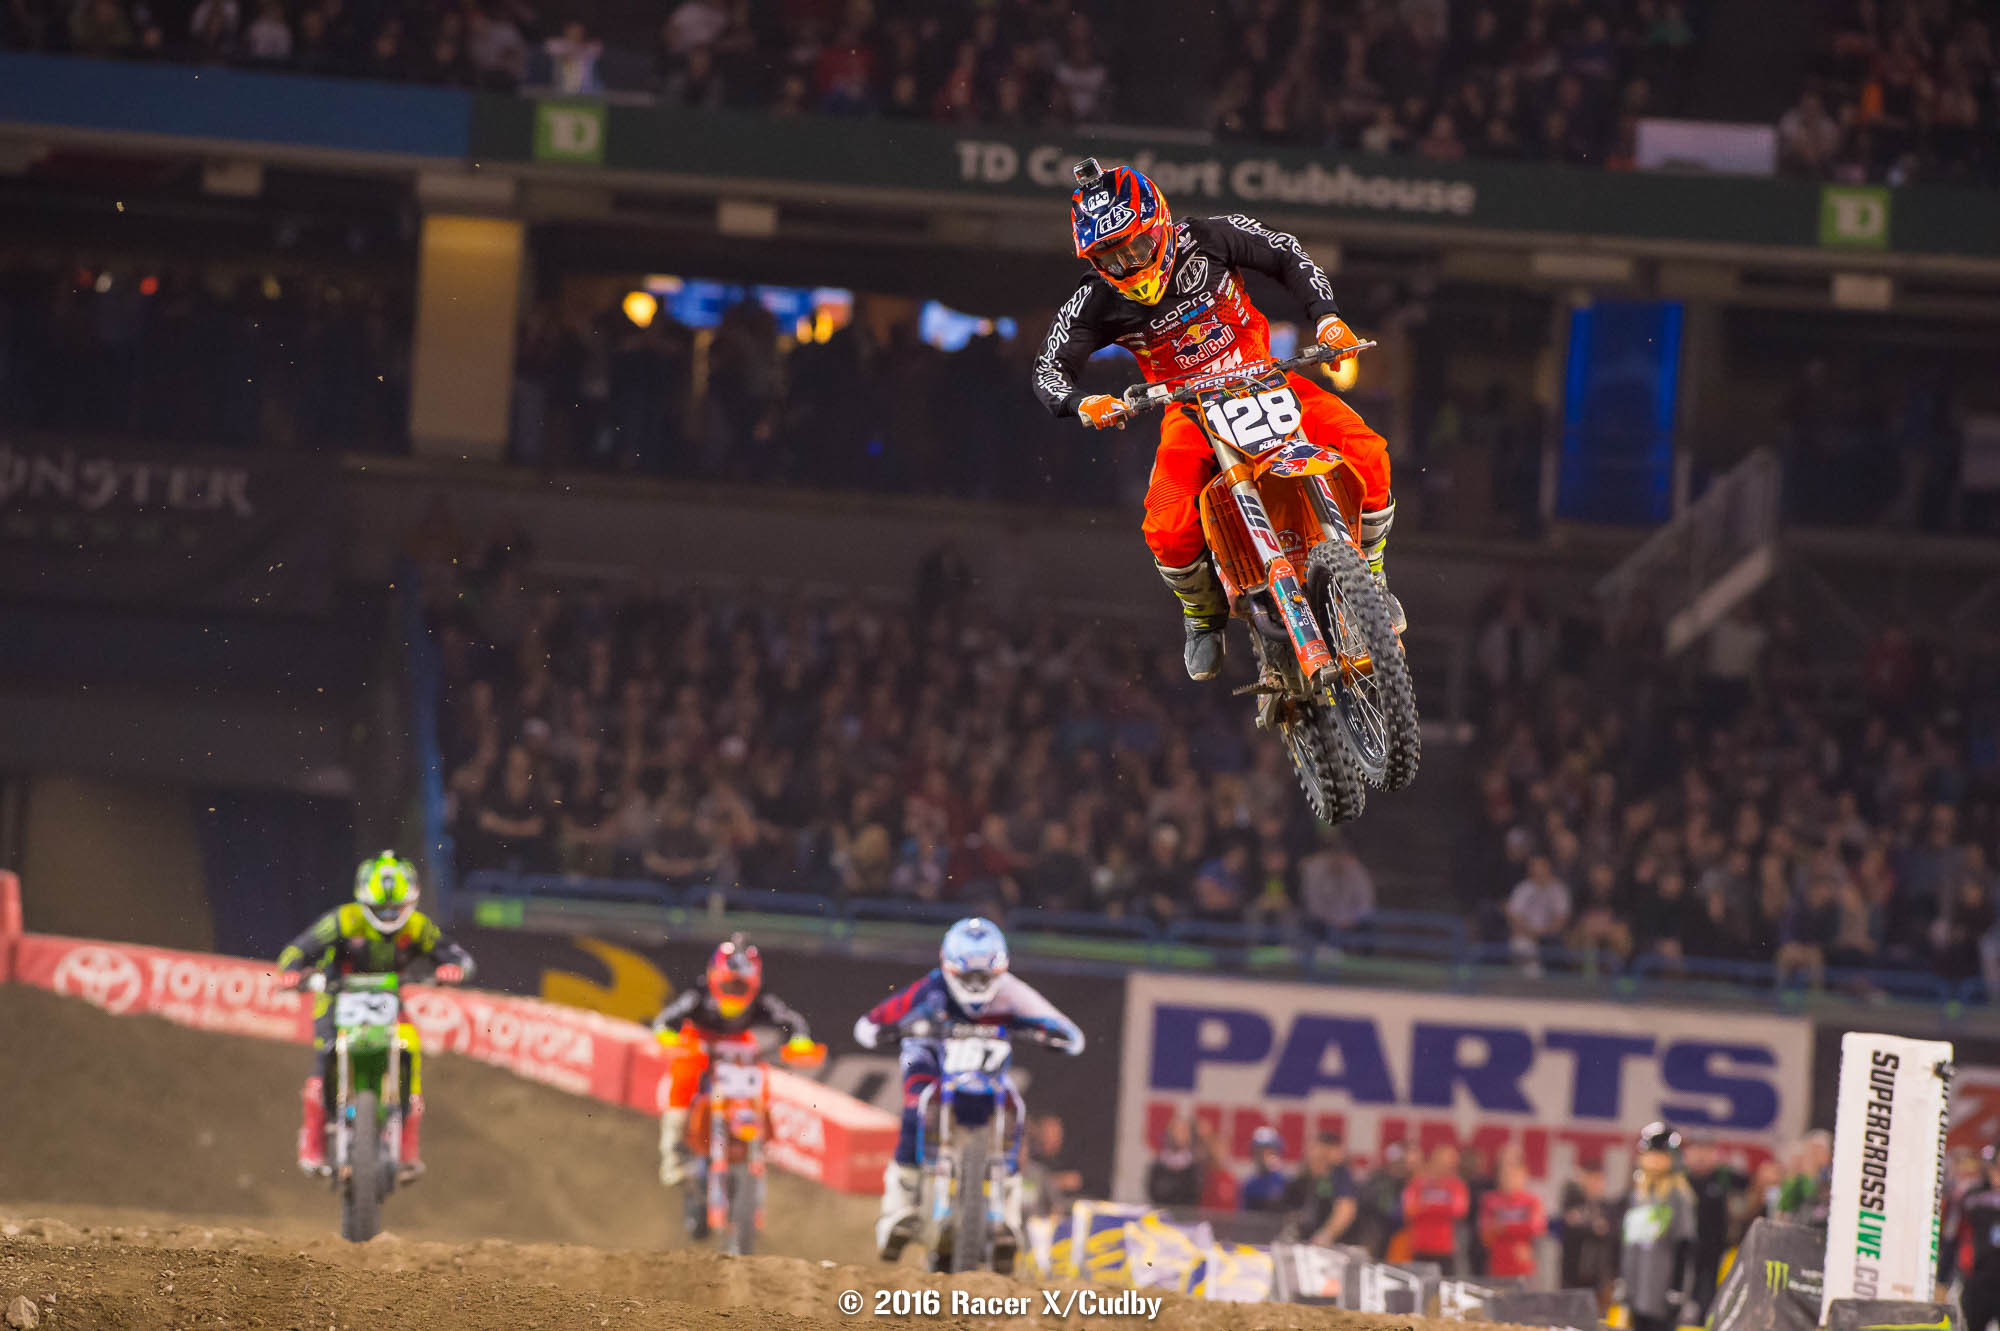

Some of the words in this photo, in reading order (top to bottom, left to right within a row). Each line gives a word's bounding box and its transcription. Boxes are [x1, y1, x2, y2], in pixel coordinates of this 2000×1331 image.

[548, 111, 598, 153] TD
[956, 142, 1018, 182] TD
[1027, 148, 1222, 198] Cofort
[1230, 159, 1477, 214] Clubhouse
[1829, 193, 1885, 236] TD
[1150, 291, 1211, 329] GoPro
[1174, 343, 1210, 370] Red
[1203, 324, 1236, 357] Bull
[1206, 386, 1301, 448] 128
[1259, 438, 1282, 451] KTM
[469, 1003, 594, 1064] TOYOTA
[1147, 1003, 1784, 1131] PARTS
